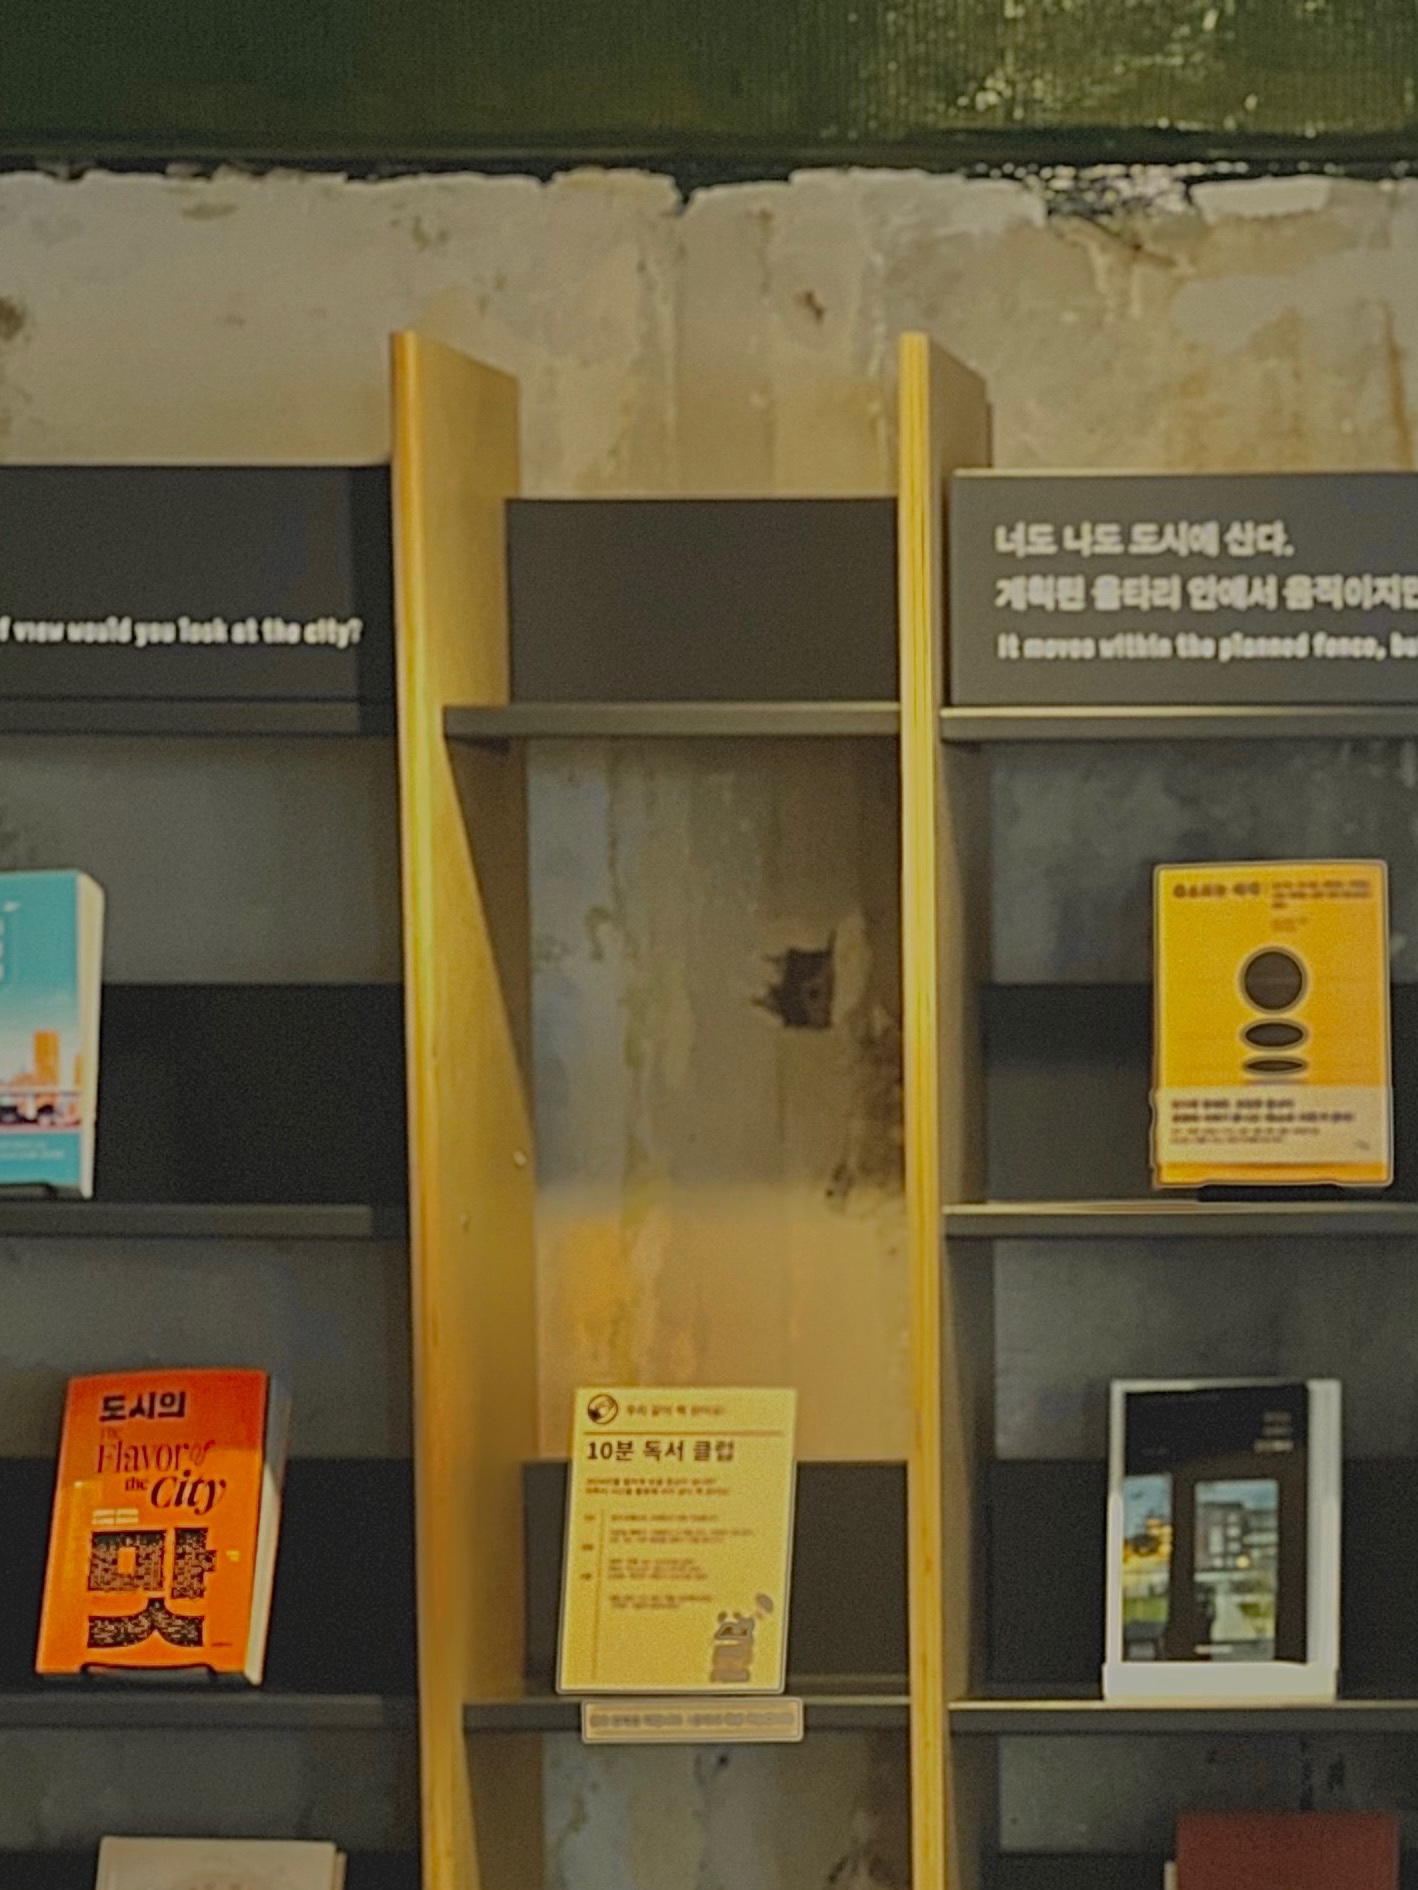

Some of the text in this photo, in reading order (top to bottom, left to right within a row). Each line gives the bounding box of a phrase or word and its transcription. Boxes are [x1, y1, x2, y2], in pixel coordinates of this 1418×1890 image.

[995, 520, 1295, 558] 너도 나도 도시에 산다.
[995, 574, 1086, 611] 계획된
[1090, 574, 1182, 611] 울타리
[1186, 574, 1278, 611] 안에서
[67, 615, 132, 644] would
[230, 616, 260, 645] at
[261, 616, 301, 645] the
[303, 617, 363, 649] city?
[998, 632, 1020, 660] It
[1022, 636, 1097, 660] moves
[1098, 631, 1173, 660] within
[1175, 631, 1216, 660] the
[1217, 630, 1310, 663] planned
[1312, 630, 1387, 661] fence,
[99, 1391, 187, 1422] 도시의
[97, 1440, 190, 1474] Flavor
[586, 1439, 736, 1463] 10분 독서 클럽
[150, 1468, 228, 1516] City
[87, 1526, 218, 1649] 맛
